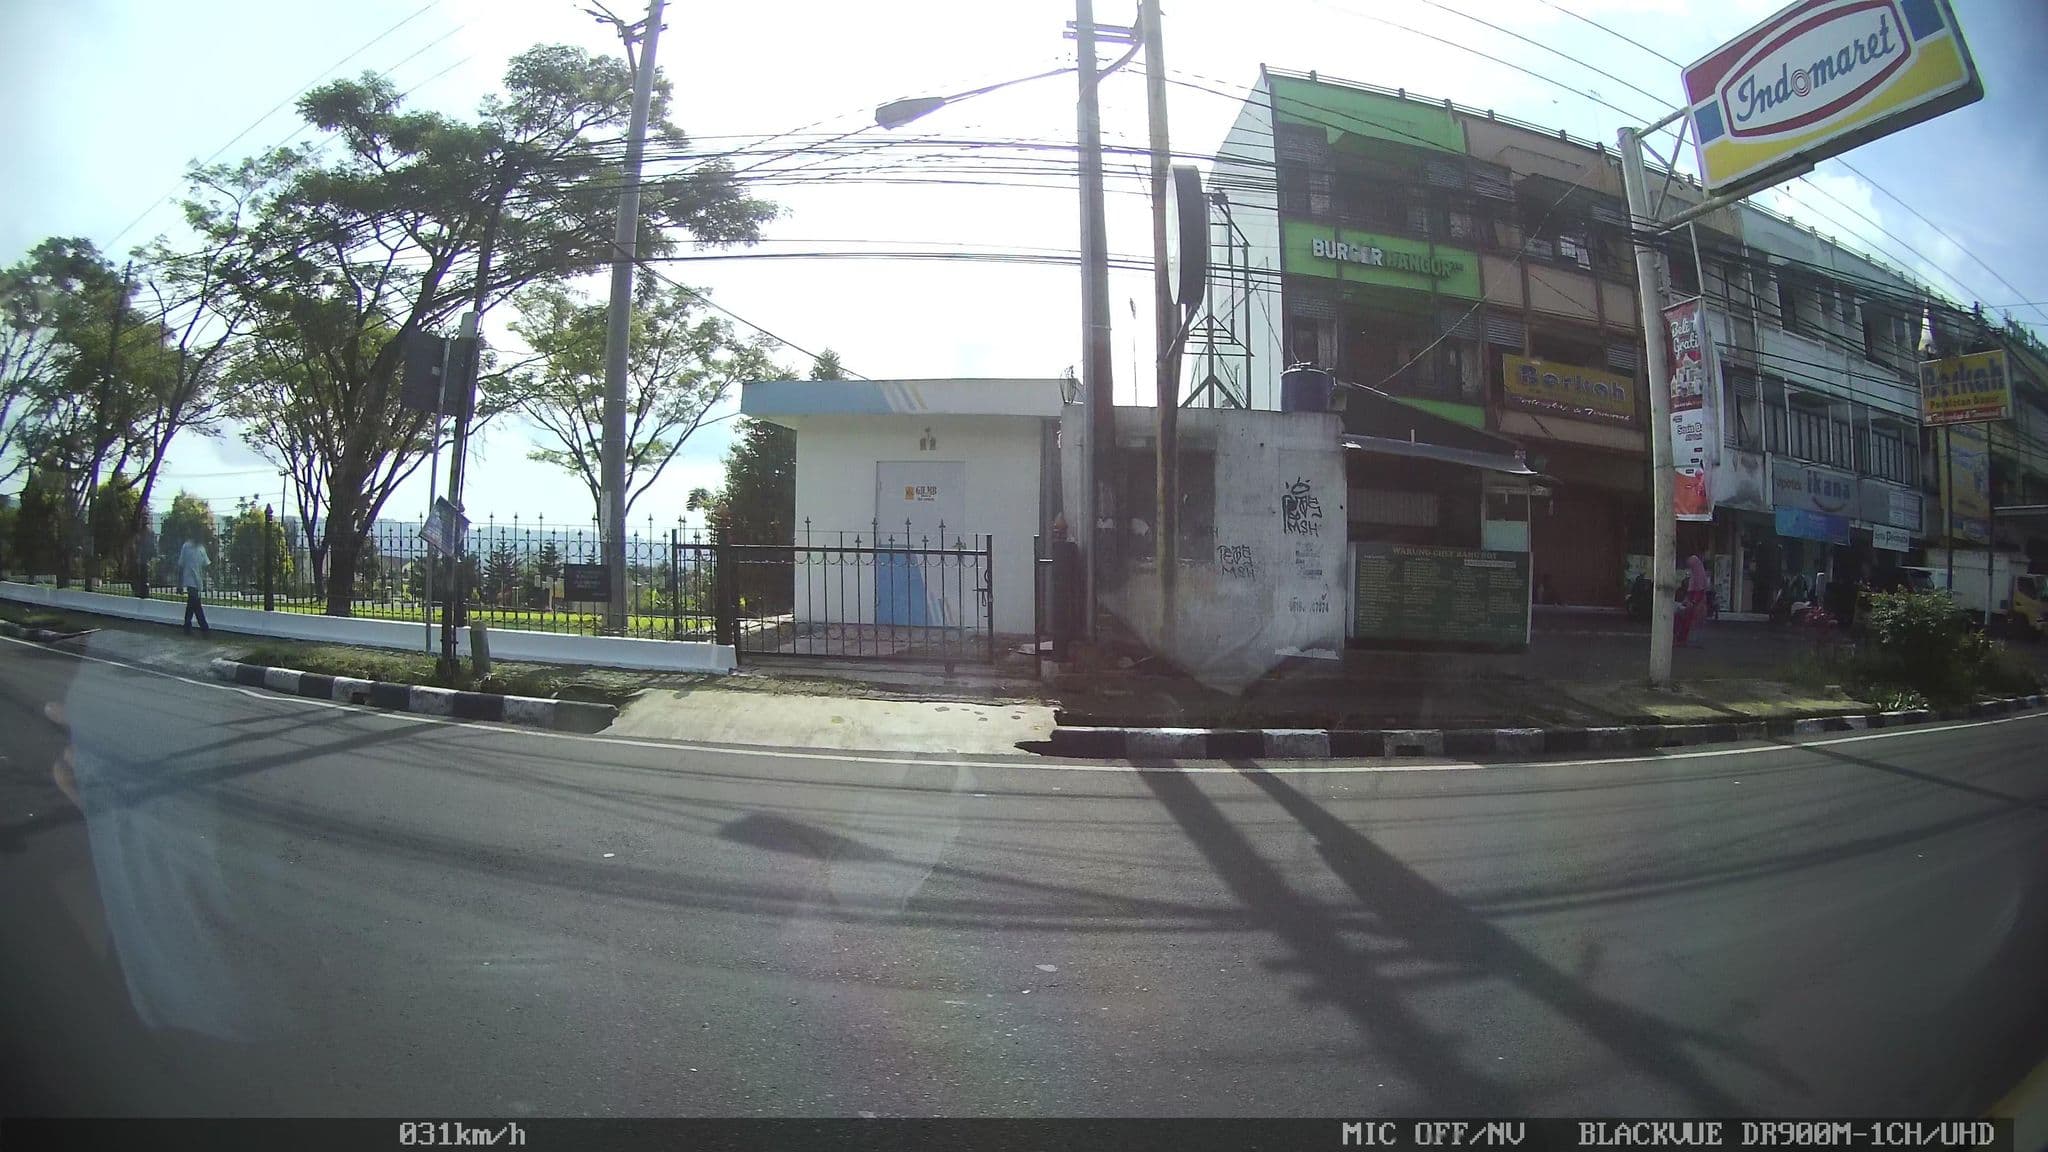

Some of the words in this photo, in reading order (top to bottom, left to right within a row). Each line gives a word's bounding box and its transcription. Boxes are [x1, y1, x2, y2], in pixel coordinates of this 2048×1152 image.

[1736, 13, 1896, 123] Indomaret
[1312, 236, 1383, 267] BURGER
[1673, 332, 1699, 361] Grati
